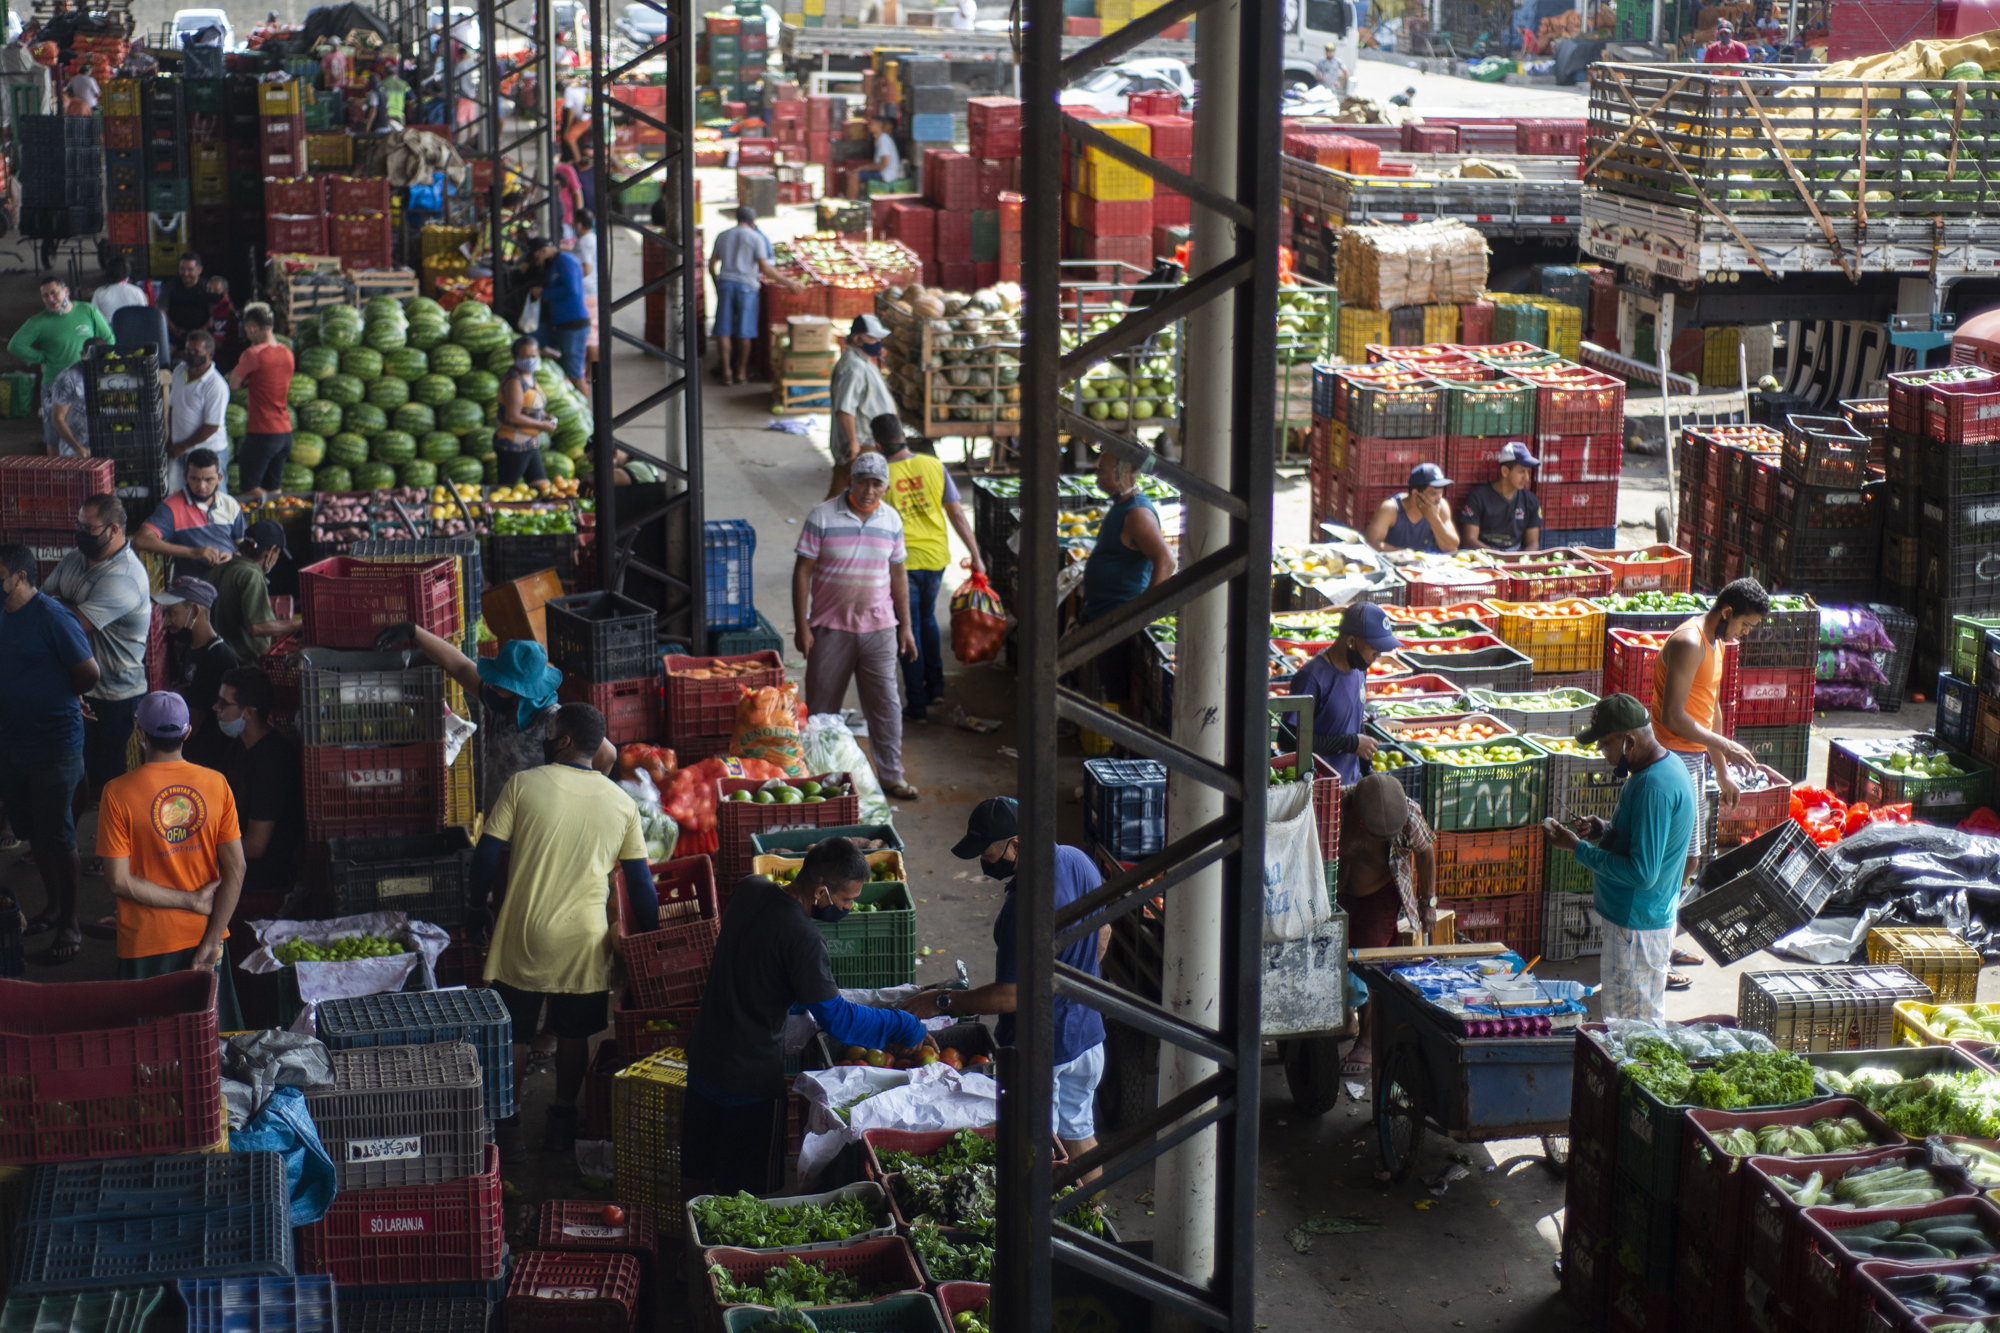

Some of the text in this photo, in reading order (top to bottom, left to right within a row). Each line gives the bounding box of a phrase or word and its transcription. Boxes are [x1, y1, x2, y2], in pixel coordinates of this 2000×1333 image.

[169, 787, 191, 795] FRUTAS
[371, 1215, 425, 1233] SÓ LARANJA
